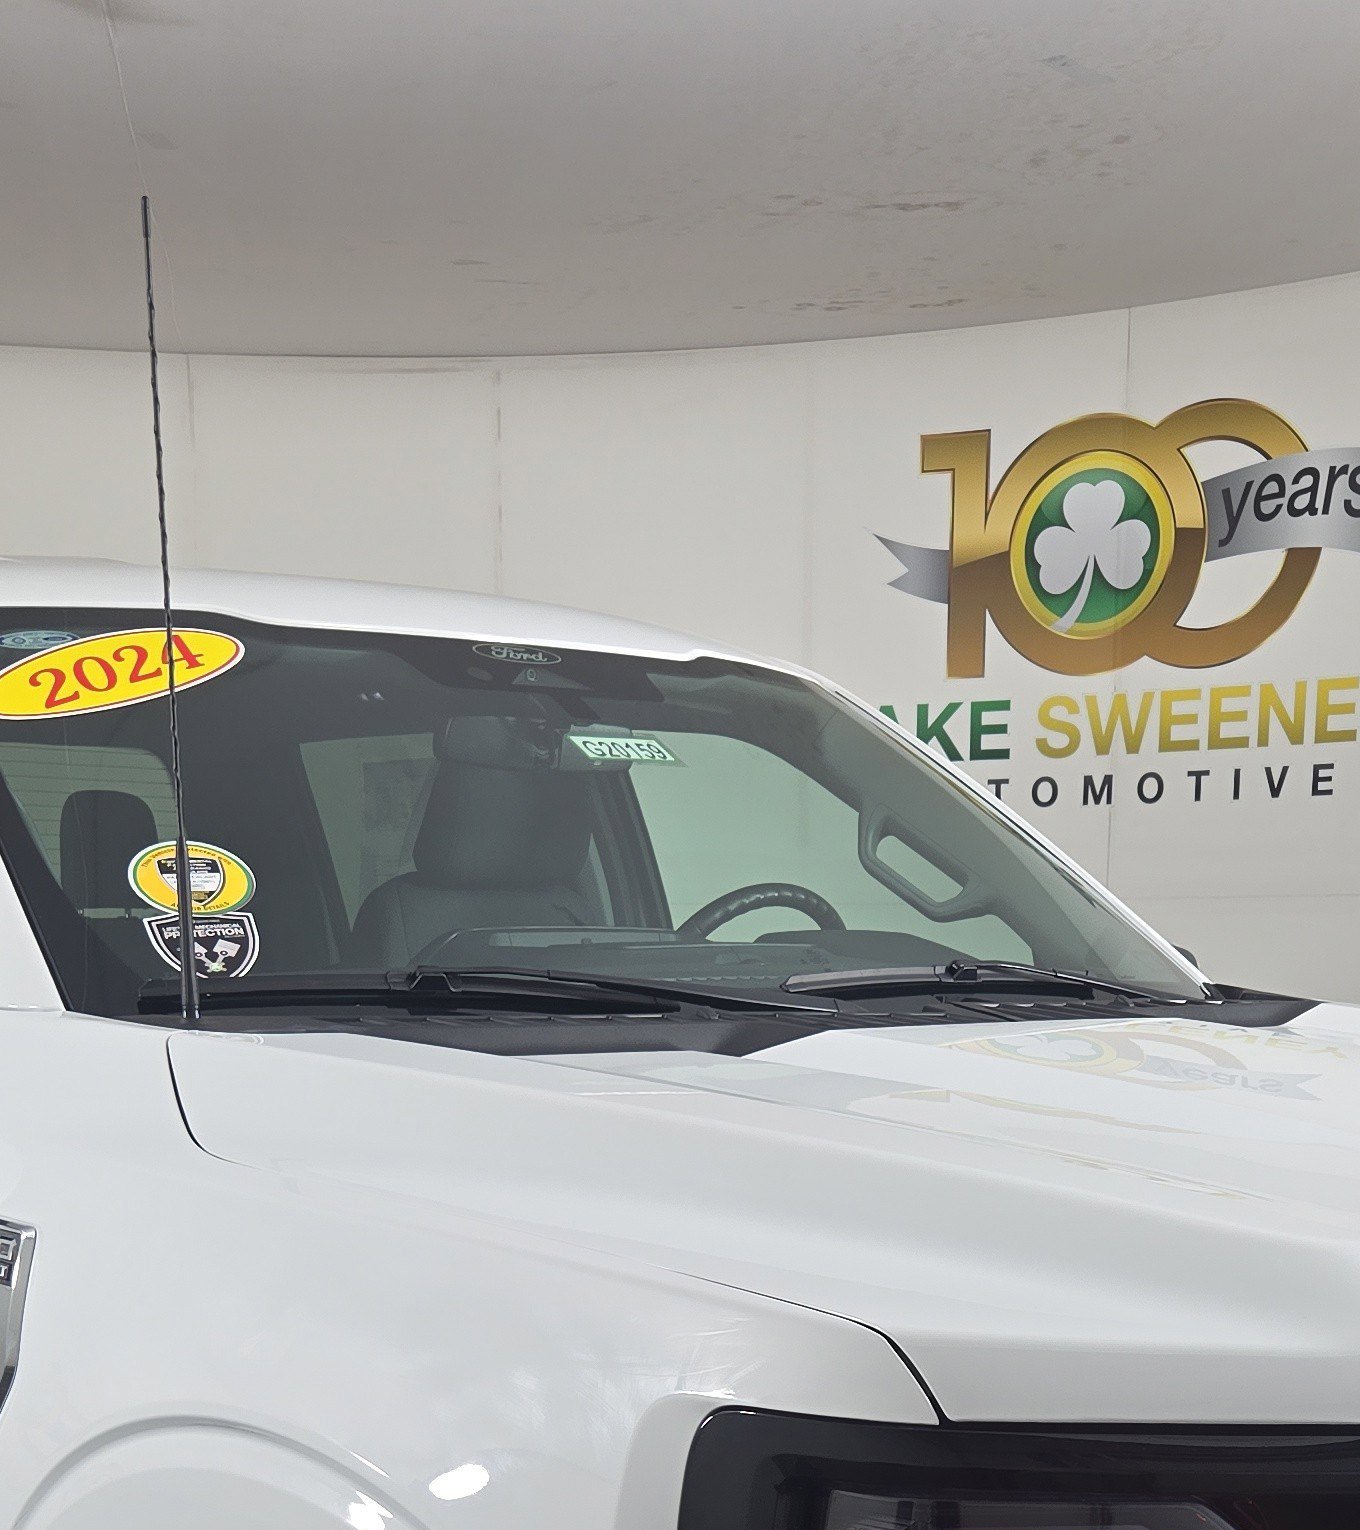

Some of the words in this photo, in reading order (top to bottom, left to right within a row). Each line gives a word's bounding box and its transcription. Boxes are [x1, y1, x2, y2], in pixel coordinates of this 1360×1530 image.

[28, 634, 206, 709] 2024
[490, 645, 548, 663] Ford
[582, 740, 668, 760] G20159
[878, 699, 1012, 762] KE
[987, 762, 1335, 809] TOMOTIVE
